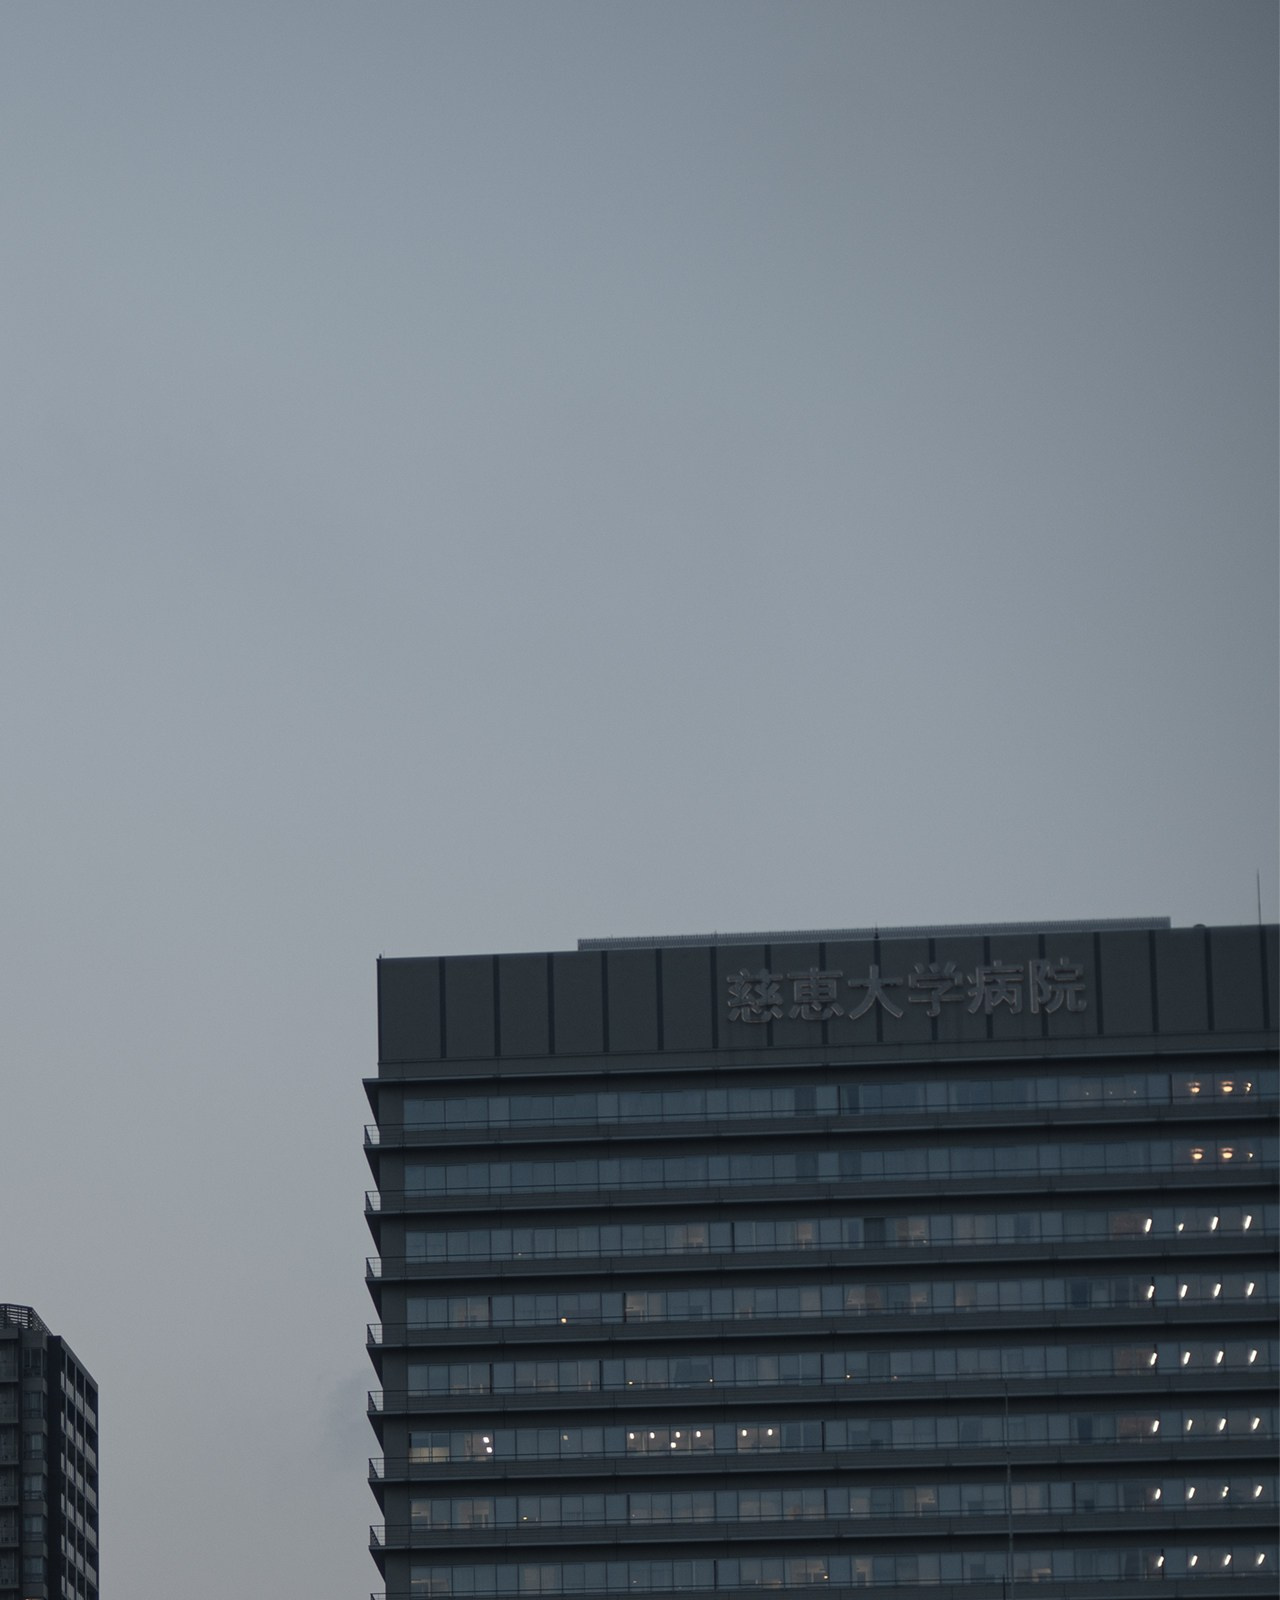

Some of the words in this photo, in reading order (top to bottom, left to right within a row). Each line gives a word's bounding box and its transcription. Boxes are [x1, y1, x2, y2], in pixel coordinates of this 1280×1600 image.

[726, 957, 1087, 1024] 慈恵大学病院
